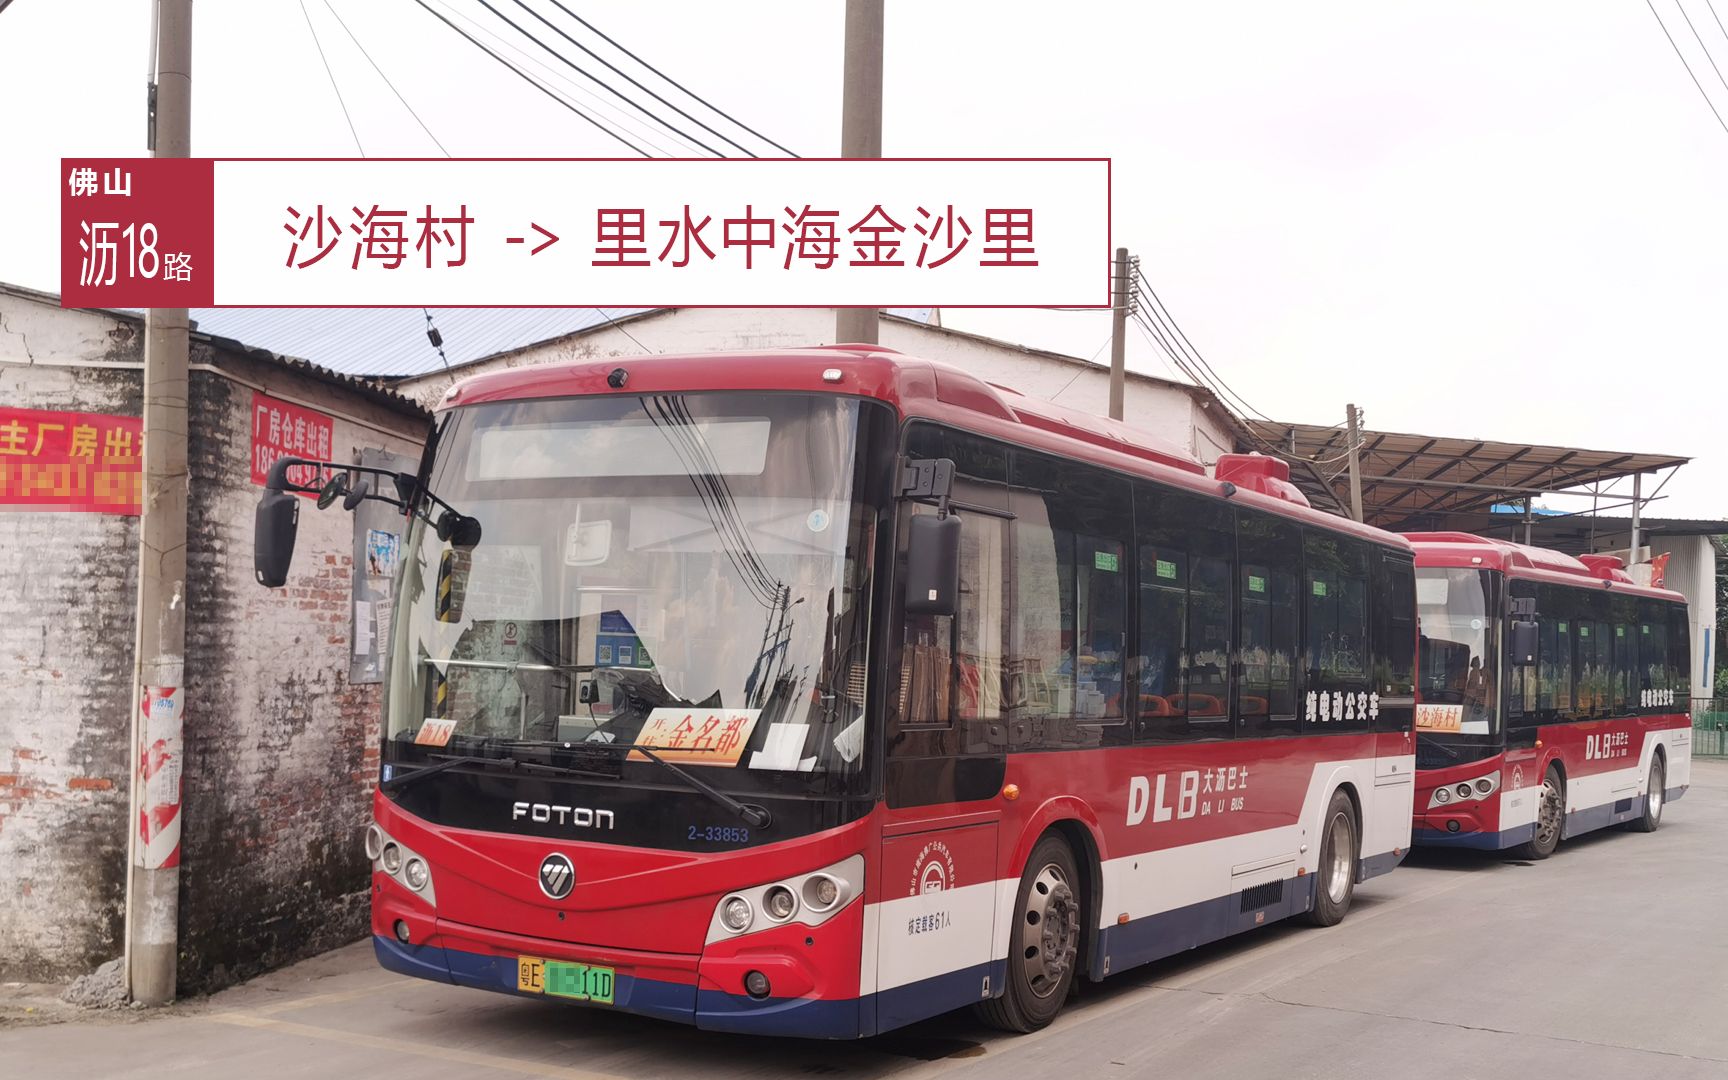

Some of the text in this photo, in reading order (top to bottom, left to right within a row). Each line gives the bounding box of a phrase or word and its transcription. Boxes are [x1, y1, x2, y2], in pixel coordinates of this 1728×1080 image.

[256, 404, 329, 460] 厂房仓库出租
[1305, 690, 1379, 722] 纯电动公交车
[1585, 733, 1611, 760] DLB
[1202, 765, 1249, 794] 大沥巴士
[1125, 770, 1200, 827] DLB
[1201, 800, 1212, 816] DA
[1230, 796, 1245, 812] BUS
[512, 801, 614, 830] FOTON
[687, 825, 749, 843] 2-33853
